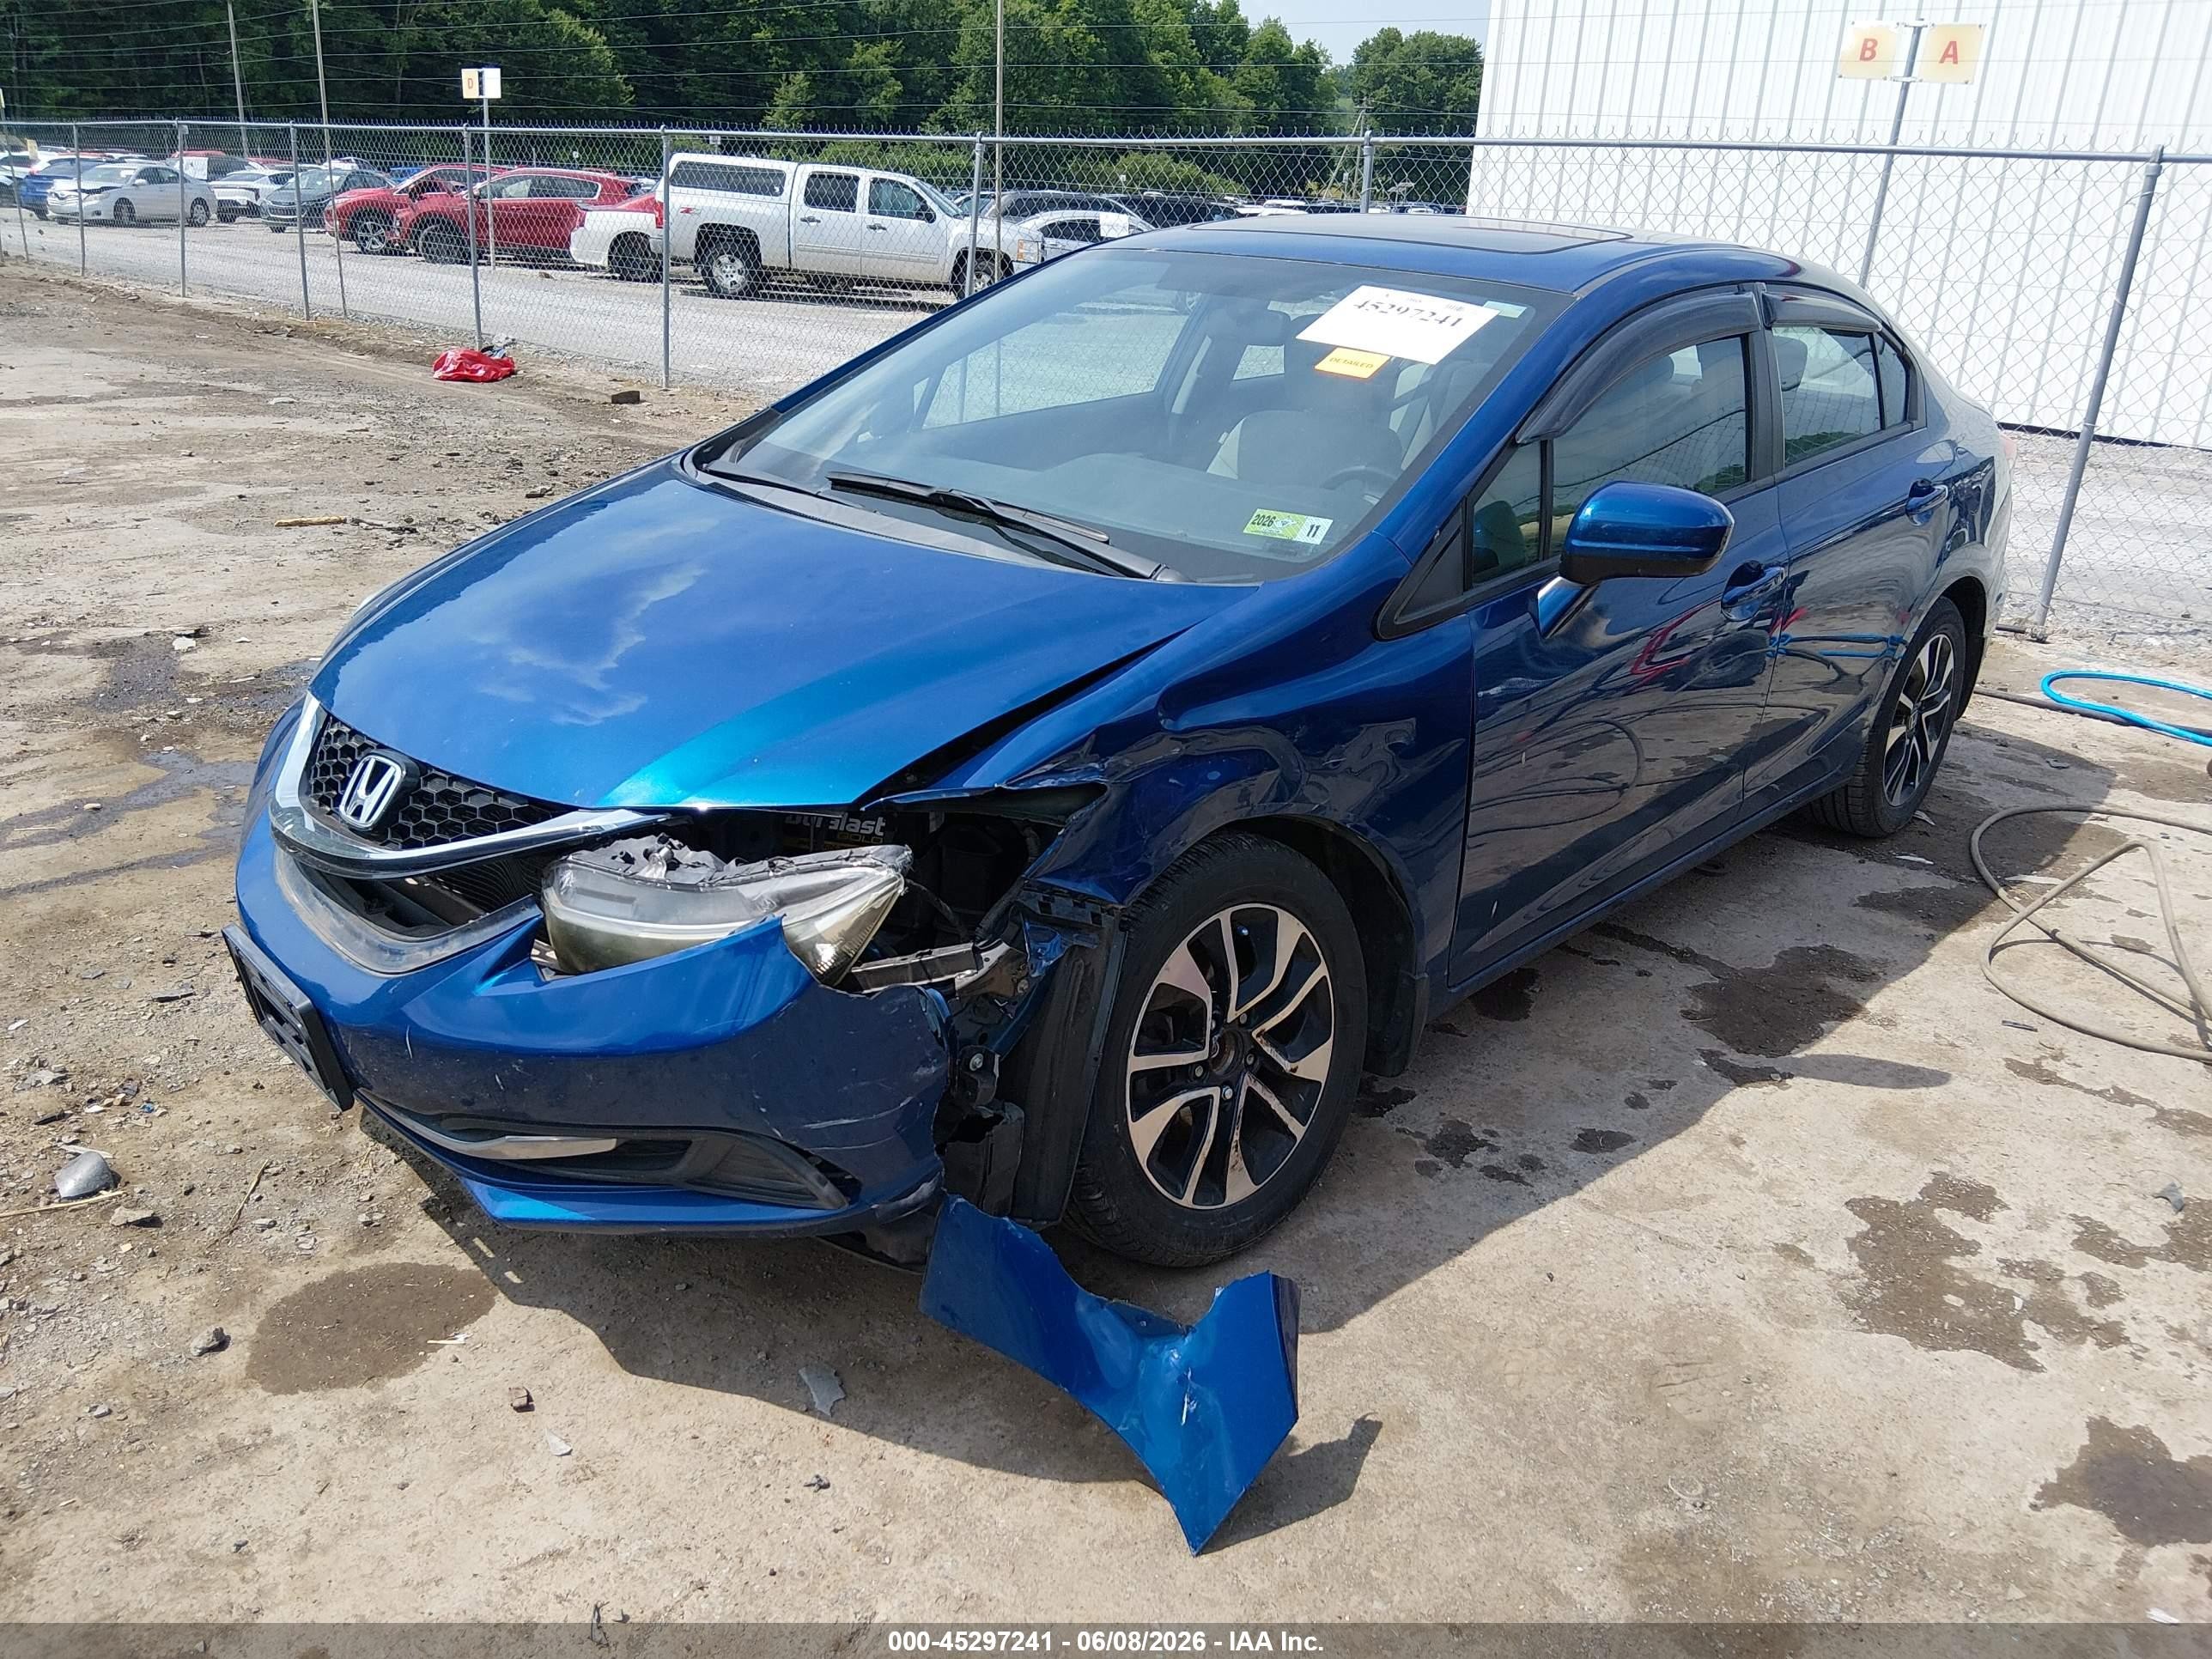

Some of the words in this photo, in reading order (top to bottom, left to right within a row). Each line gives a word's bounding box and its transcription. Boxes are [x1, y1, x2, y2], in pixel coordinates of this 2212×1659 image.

[1859, 38, 1878, 62] B
[1938, 40, 1959, 64] A
[1353, 300, 1463, 327] 45297241
[1329, 357, 1374, 369] DETAILED
[1251, 514, 1277, 527] 2026
[1307, 525, 1321, 538] 11
[837, 832, 884, 844] GOLD
